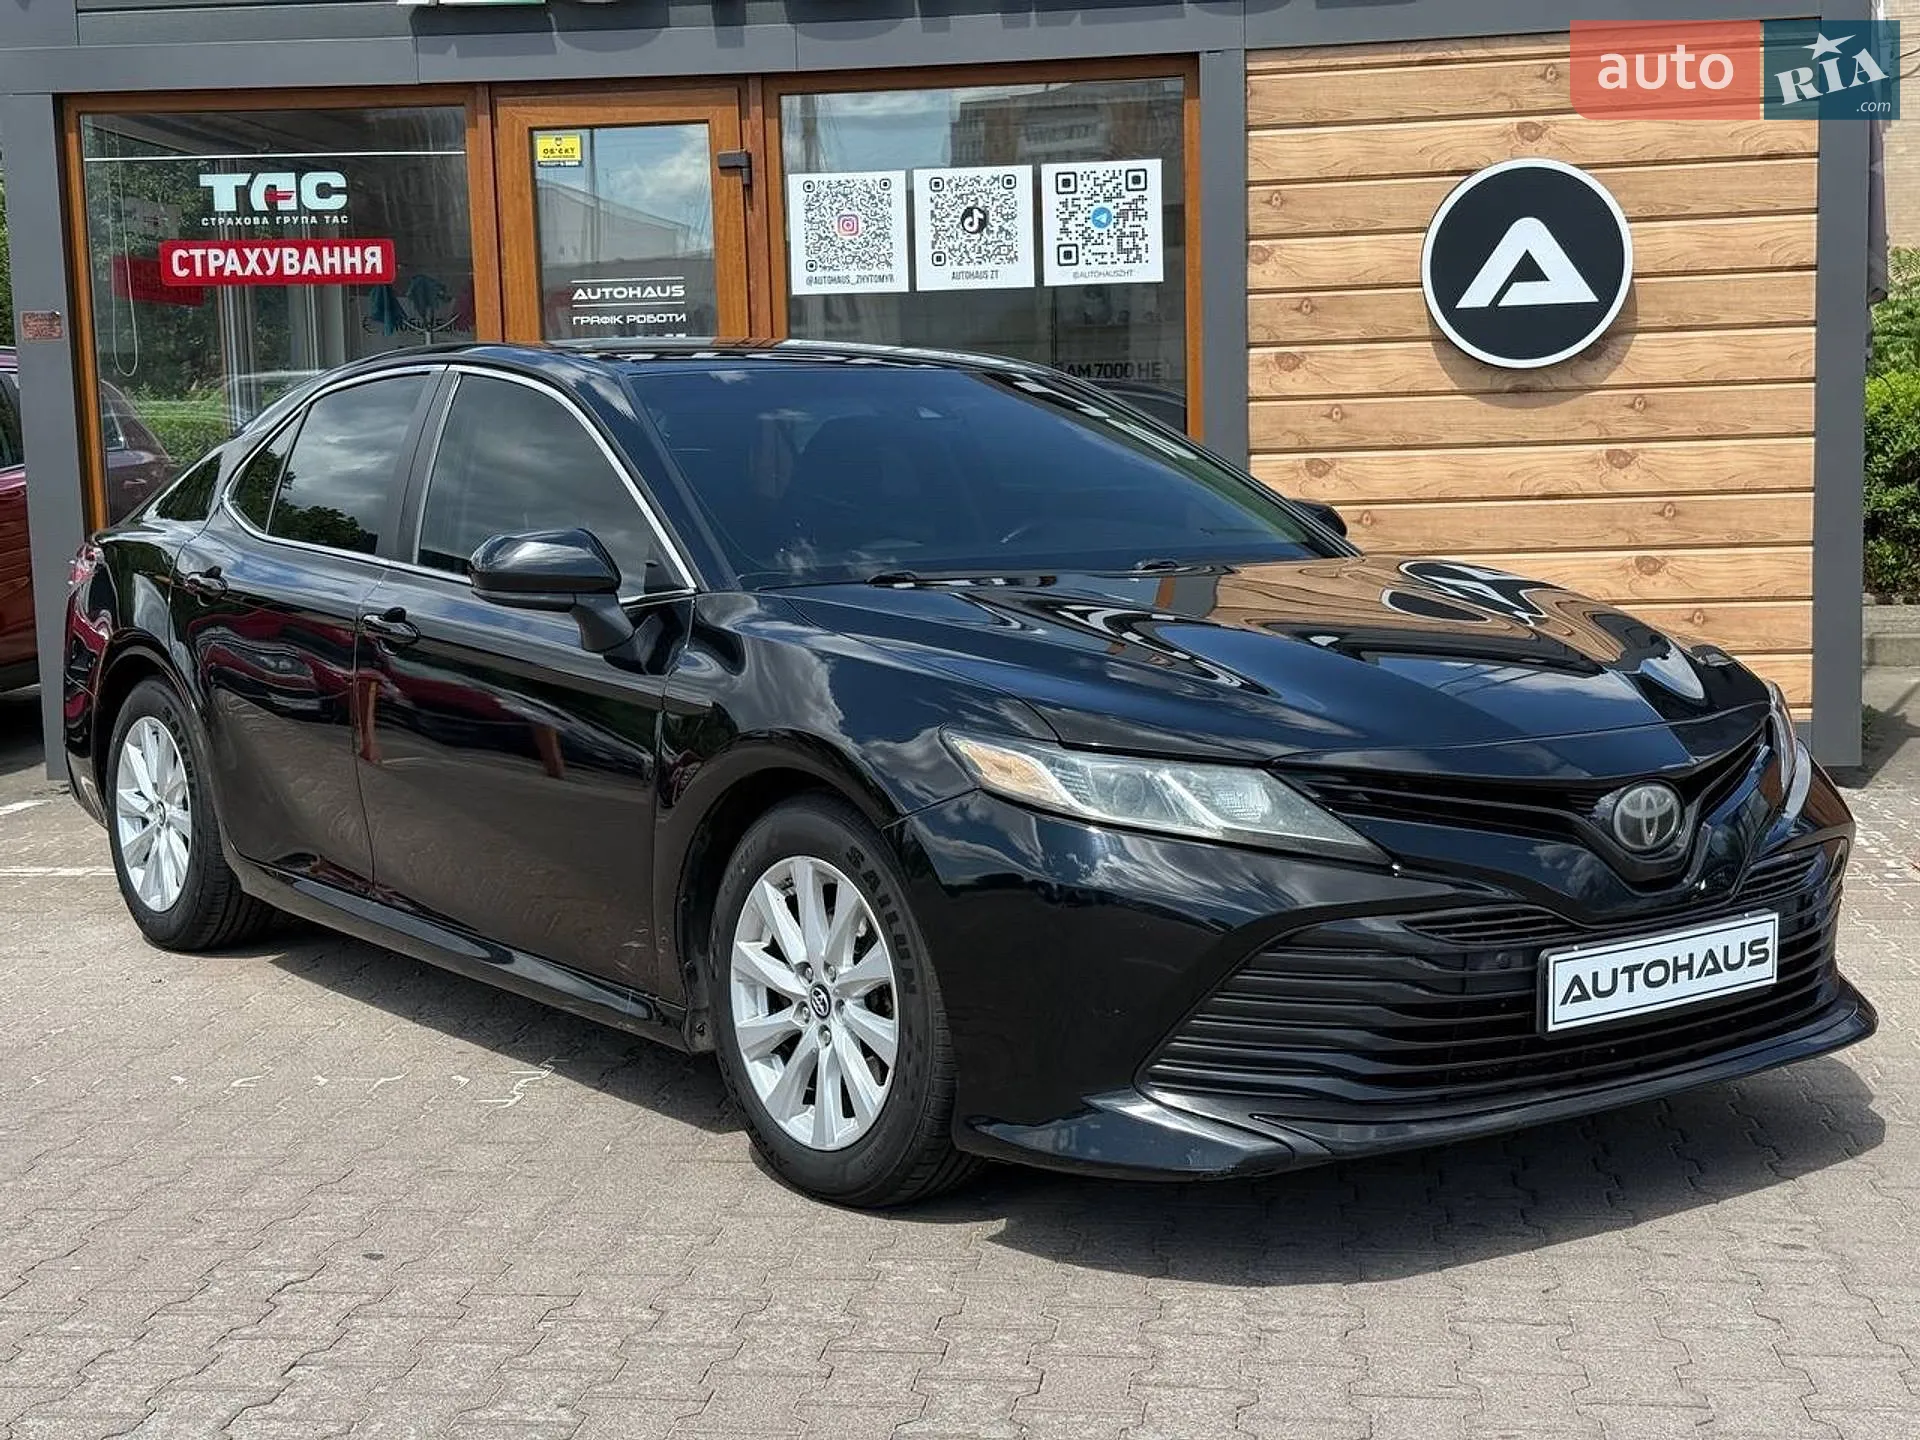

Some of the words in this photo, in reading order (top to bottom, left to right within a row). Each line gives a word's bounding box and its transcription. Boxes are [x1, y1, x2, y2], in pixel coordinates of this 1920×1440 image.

[201, 216, 269, 227] СТРАХОВА
[276, 215, 318, 226] ГРУПА
[324, 215, 348, 225] ТАС
[171, 246, 383, 278] СТРАХУВАННЯ
[951, 269, 988, 280] AUTOHAUS
[990, 269, 999, 280] ZT
[572, 285, 685, 300] AUTOHAUS
[573, 316, 623, 325] ГРАФІК
[626, 313, 686, 324] РОБОТИ
[1559, 936, 1770, 1006] AUTOHAUS
